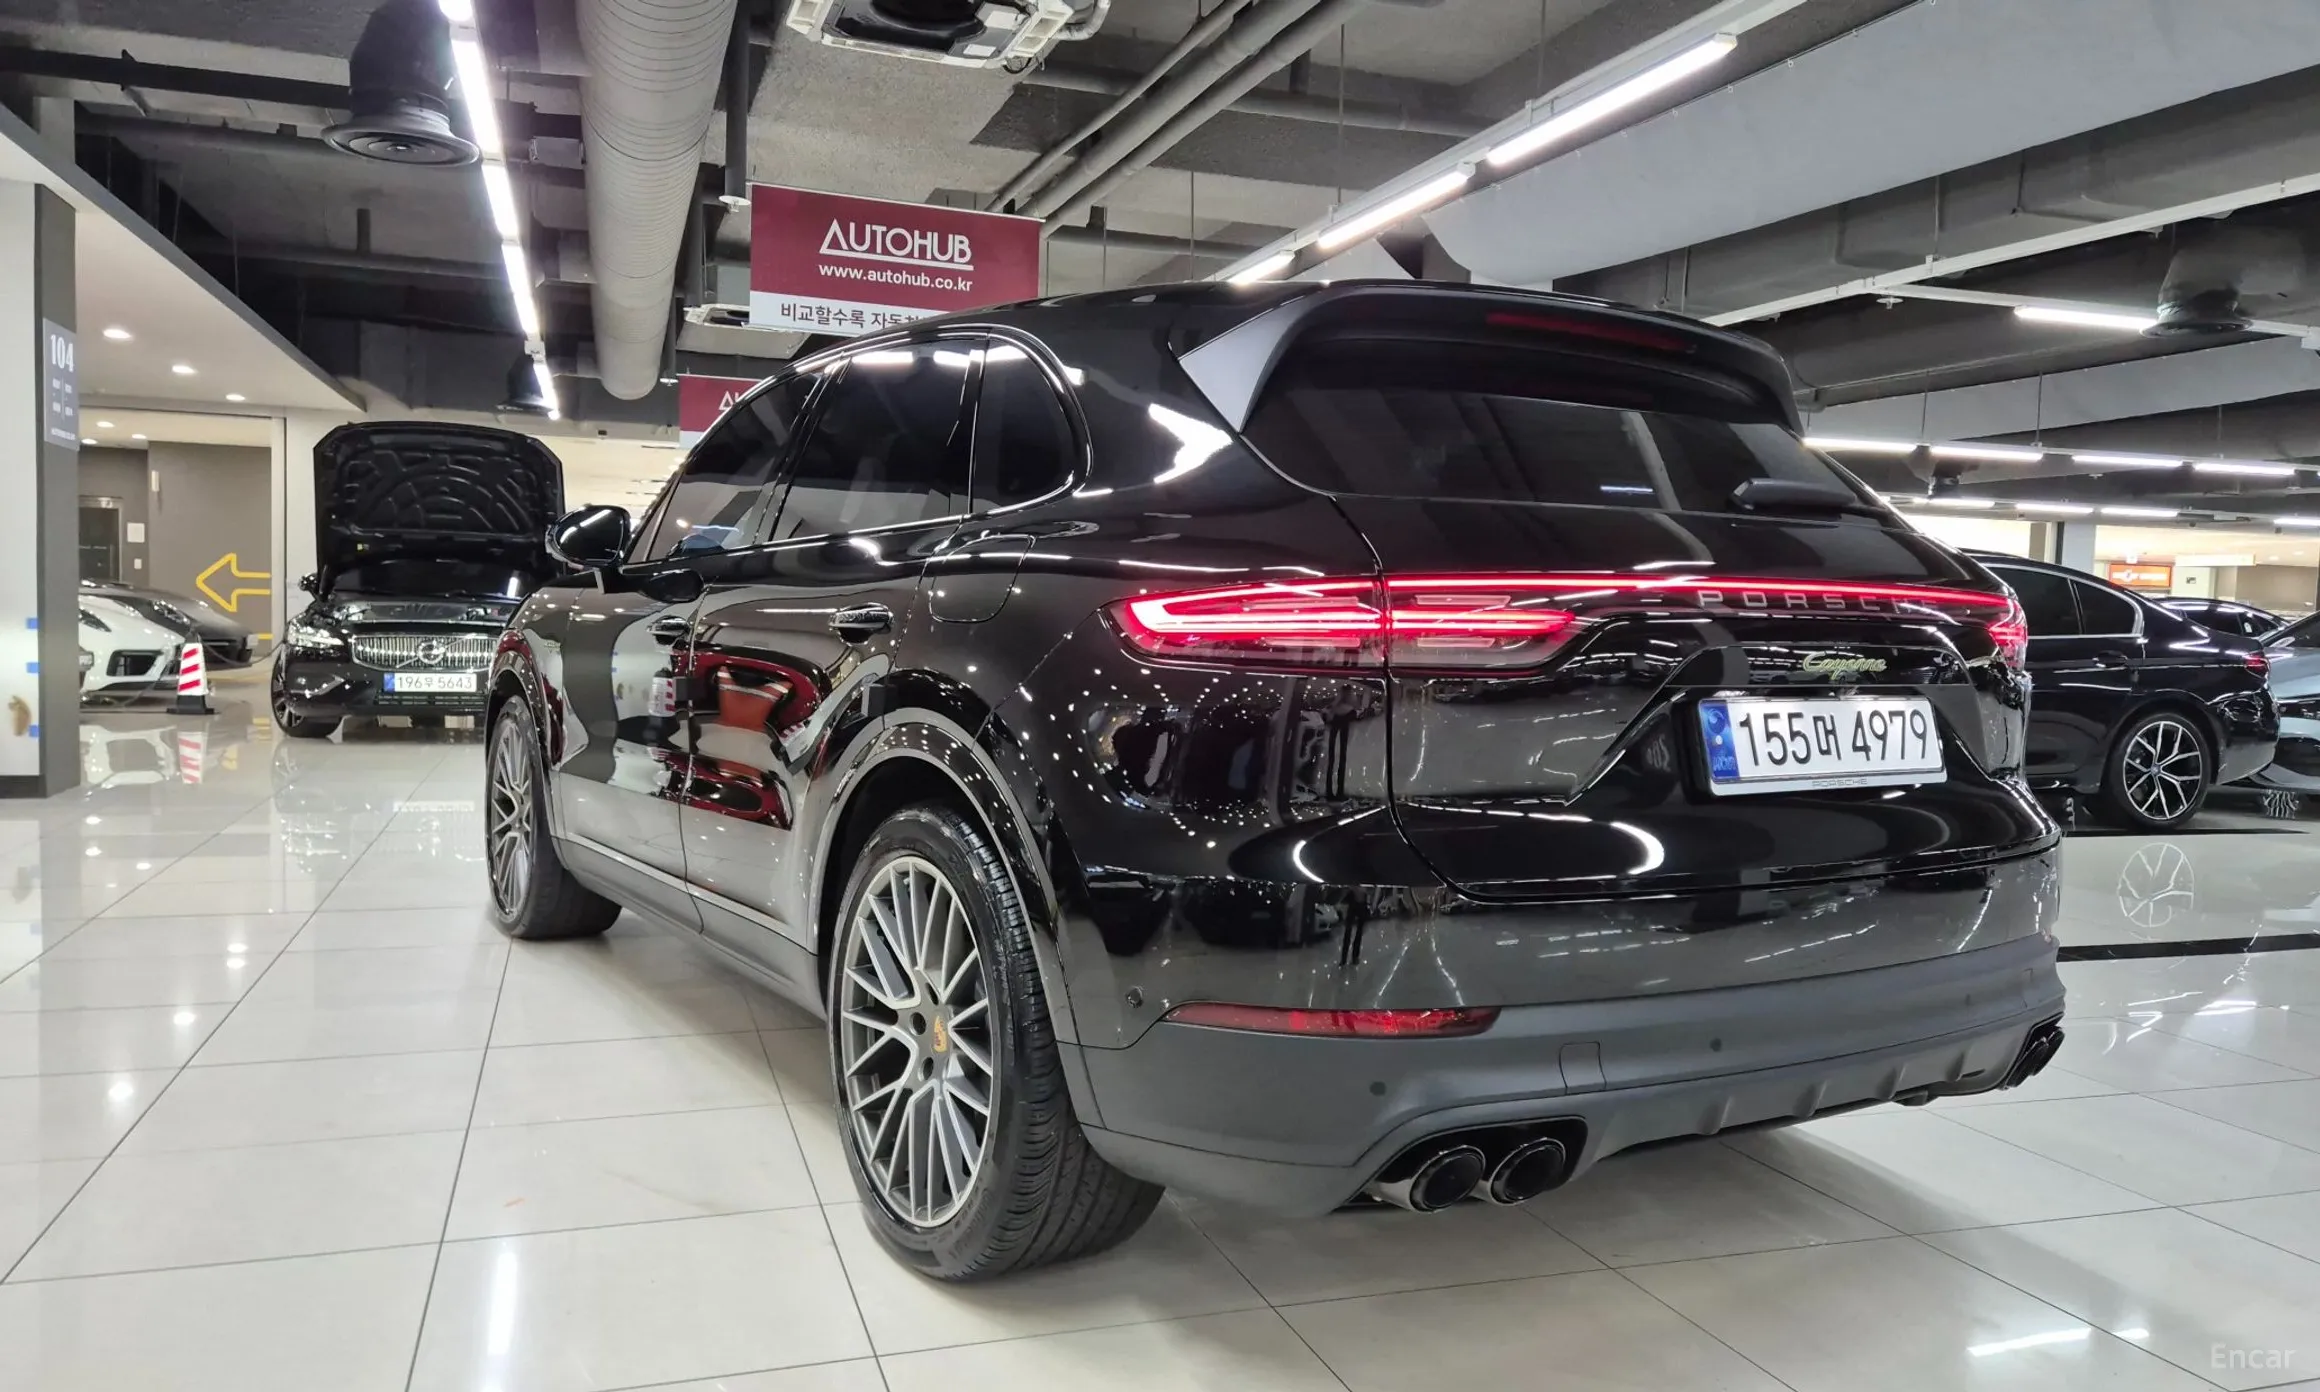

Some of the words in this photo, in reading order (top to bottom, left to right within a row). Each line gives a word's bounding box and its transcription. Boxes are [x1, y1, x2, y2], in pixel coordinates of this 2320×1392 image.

[819, 218, 974, 268] AUTOHUB
[818, 264, 973, 291] www.autohub.co.kr
[781, 303, 866, 328] 비교할수록
[51, 334, 74, 372] 104
[1697, 590, 1937, 613] PORSCHE
[1803, 651, 1887, 680] Cayenne
[437, 676, 473, 689] 5643
[1739, 712, 1842, 767] 155머
[1852, 709, 1927, 761] 4979
